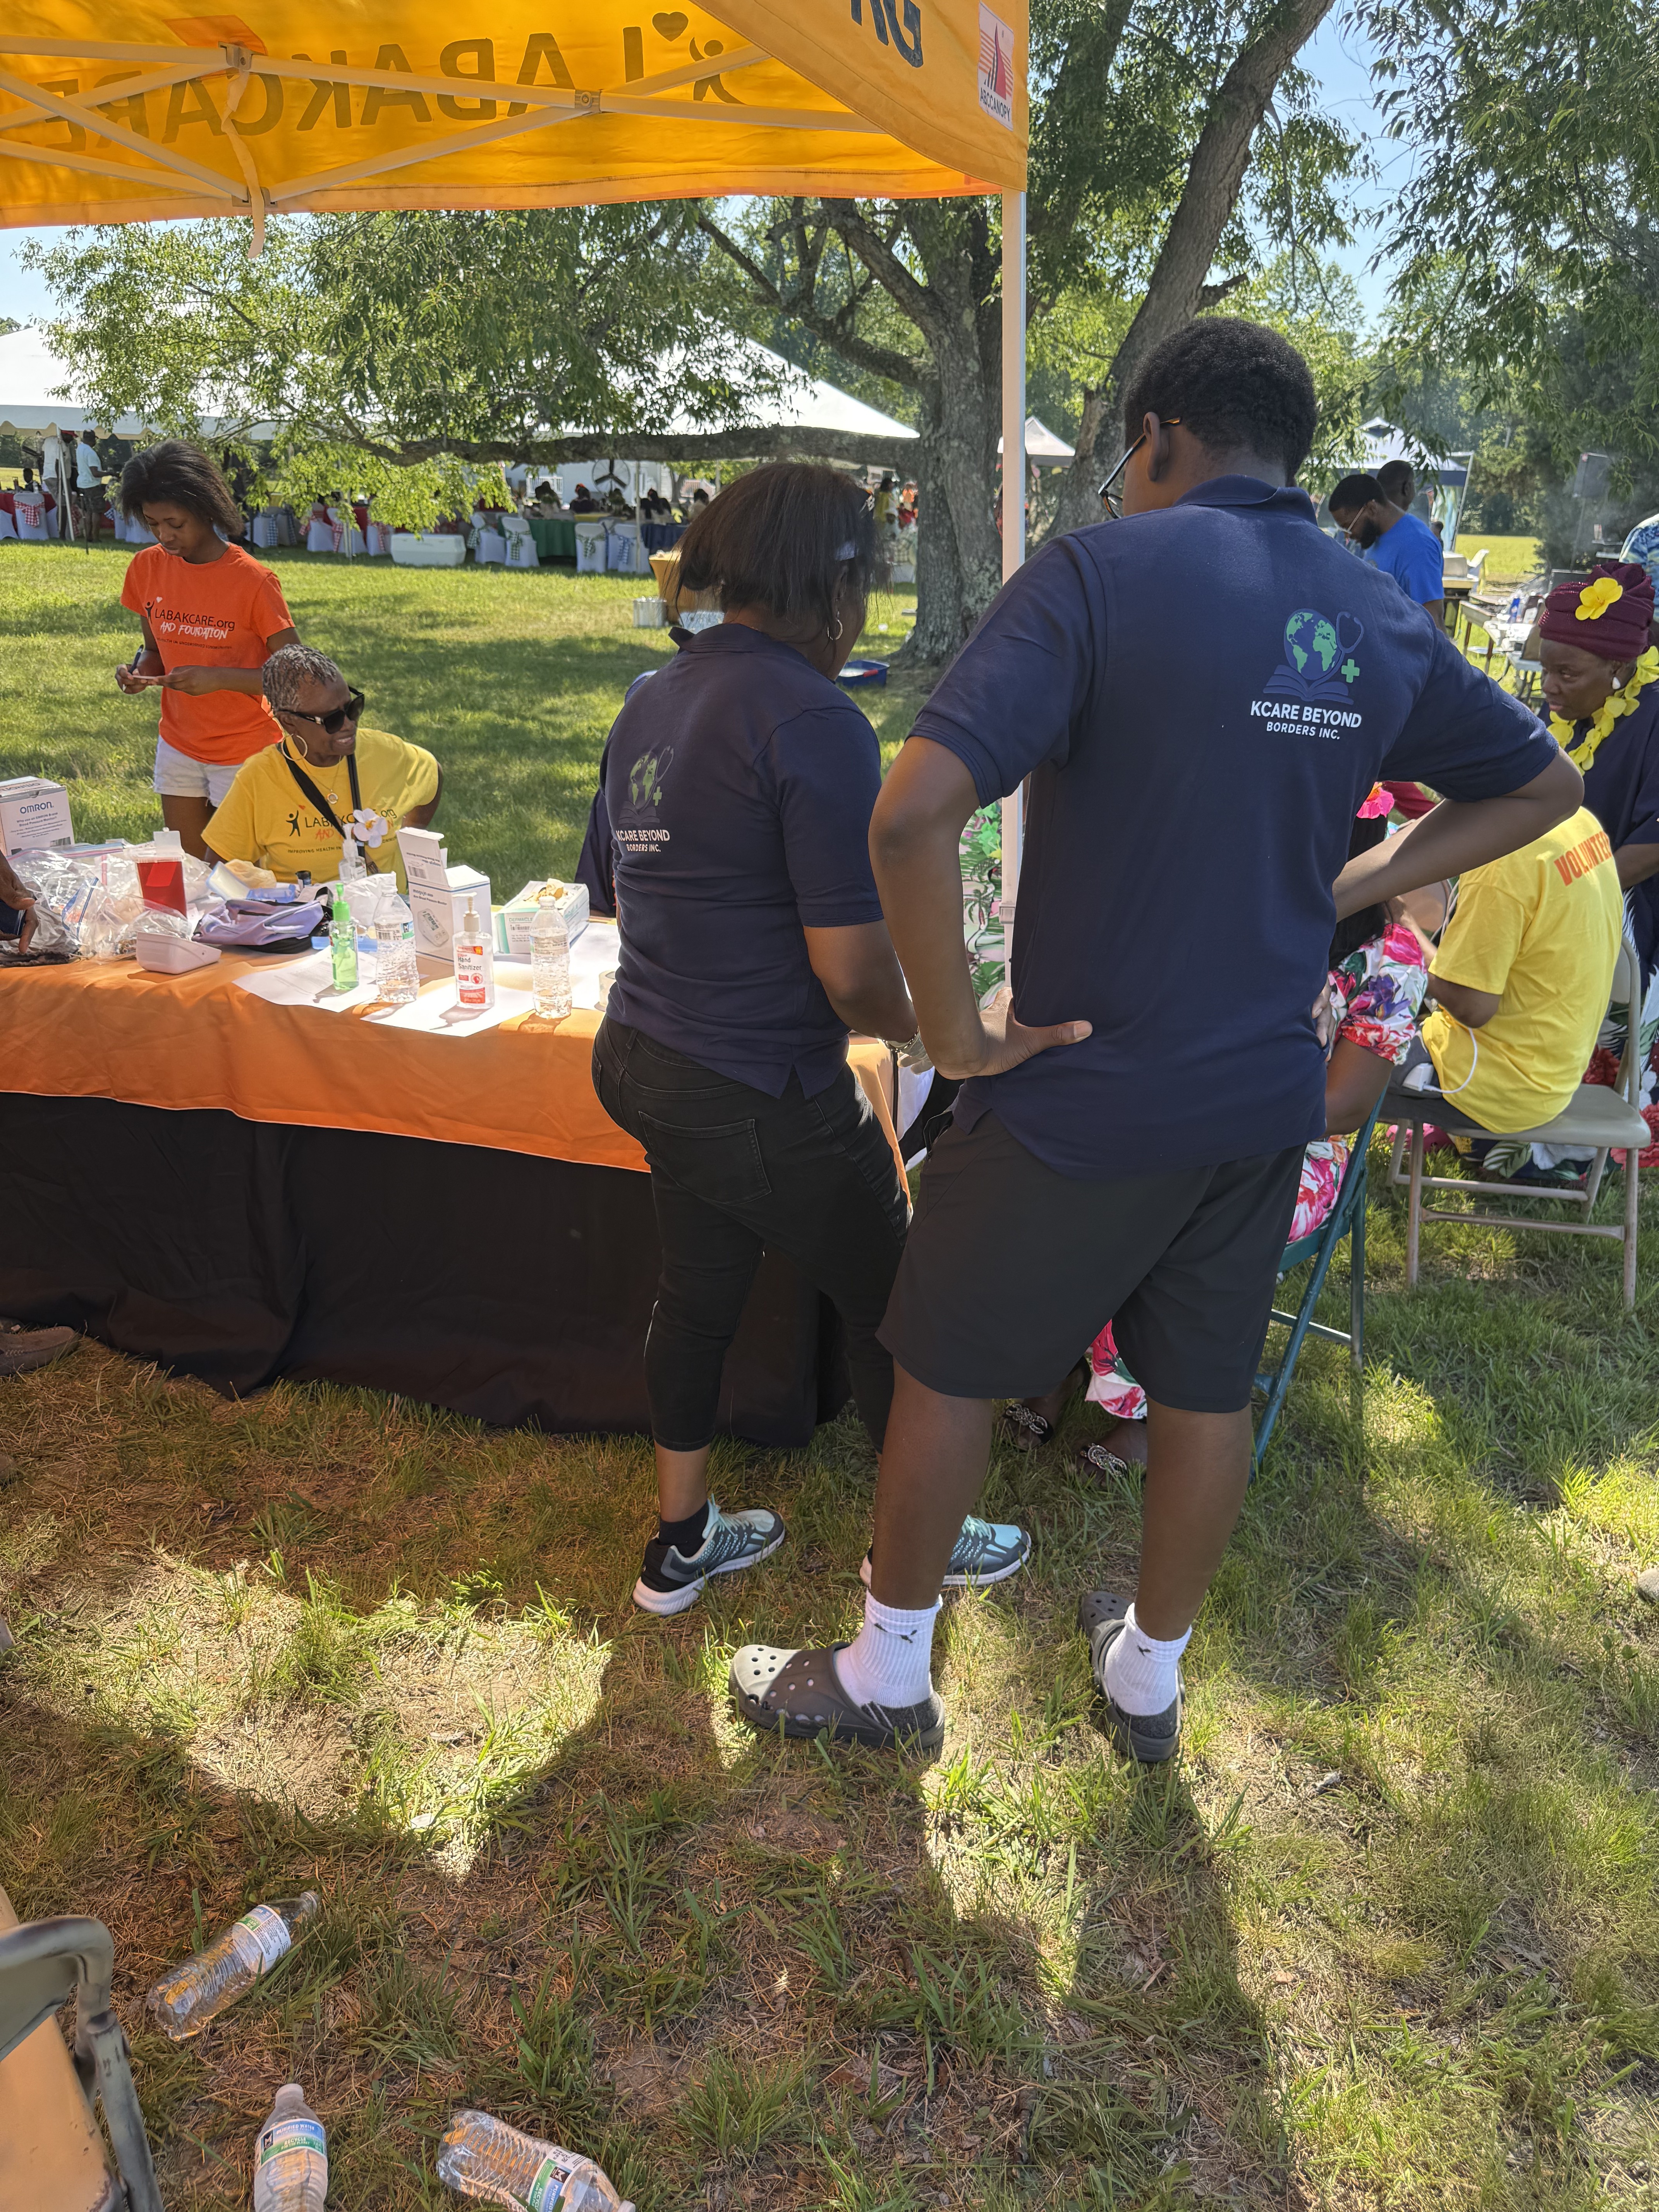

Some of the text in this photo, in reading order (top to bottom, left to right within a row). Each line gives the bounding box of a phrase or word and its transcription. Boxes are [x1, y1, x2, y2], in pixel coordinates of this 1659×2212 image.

[980, 87, 1010, 122] ABCCANOPY
[155, 608, 235, 631] LABAKCARE.org
[1250, 701, 1362, 728] KCARE BEYOND
[1266, 721, 1340, 740] BORDERS INC.
[20, 801, 52, 814] OMRON
[616, 829, 670, 841] KCARE BEYOND
[649, 844, 661, 852] INC.
[1554, 831, 1612, 887] VOLUNTEE
[276, 2124, 299, 2135] PURIFIED
[284, 2137, 306, 2145] RECYCLE
[548, 2184, 559, 2210] PURIFIED
